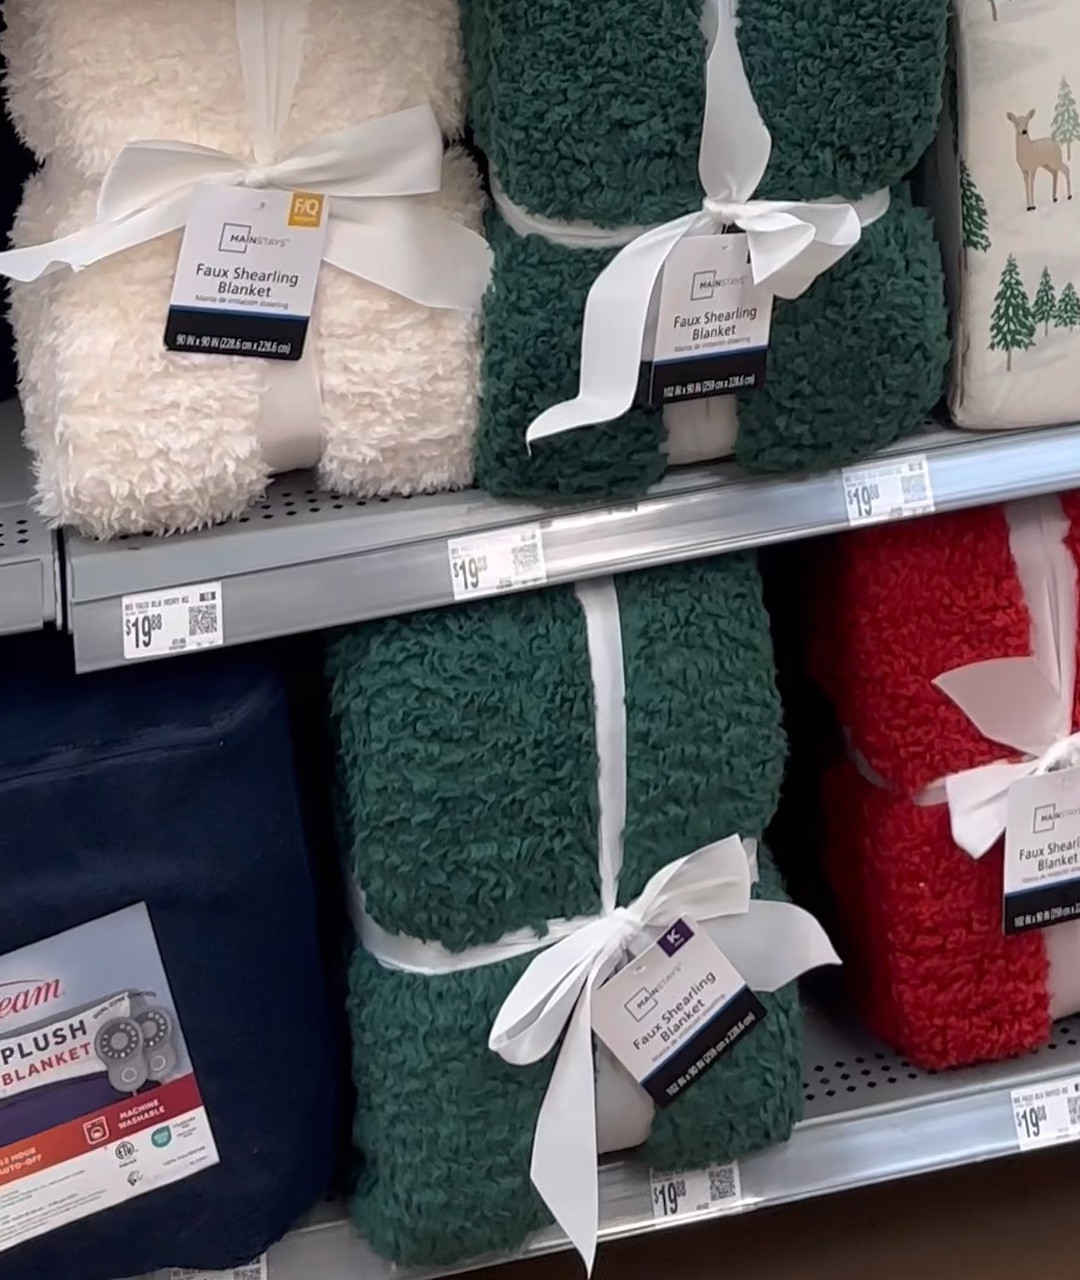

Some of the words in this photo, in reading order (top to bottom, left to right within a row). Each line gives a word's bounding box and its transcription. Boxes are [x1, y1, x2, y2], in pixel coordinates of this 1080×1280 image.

[196, 263, 229, 279] Faux
[233, 267, 299, 287] Shearling
[218, 281, 271, 298] Blanket
[674, 315, 700, 328] Faux
[705, 307, 757, 325] Shearling
[692, 325, 736, 340] Blanket
[1019, 846, 1044, 861] Faux
[1038, 853, 1078, 871] Blanket
[666, 928, 681, 944] K
[632, 1024, 663, 1050] Faux
[661, 971, 717, 1024] Shearling
[660, 999, 706, 1043] Blanket
[0, 1019, 87, 1065] PLUSH
[2, 1042, 91, 1086] BLANKET
[120, 1099, 159, 1119] MACHINE
